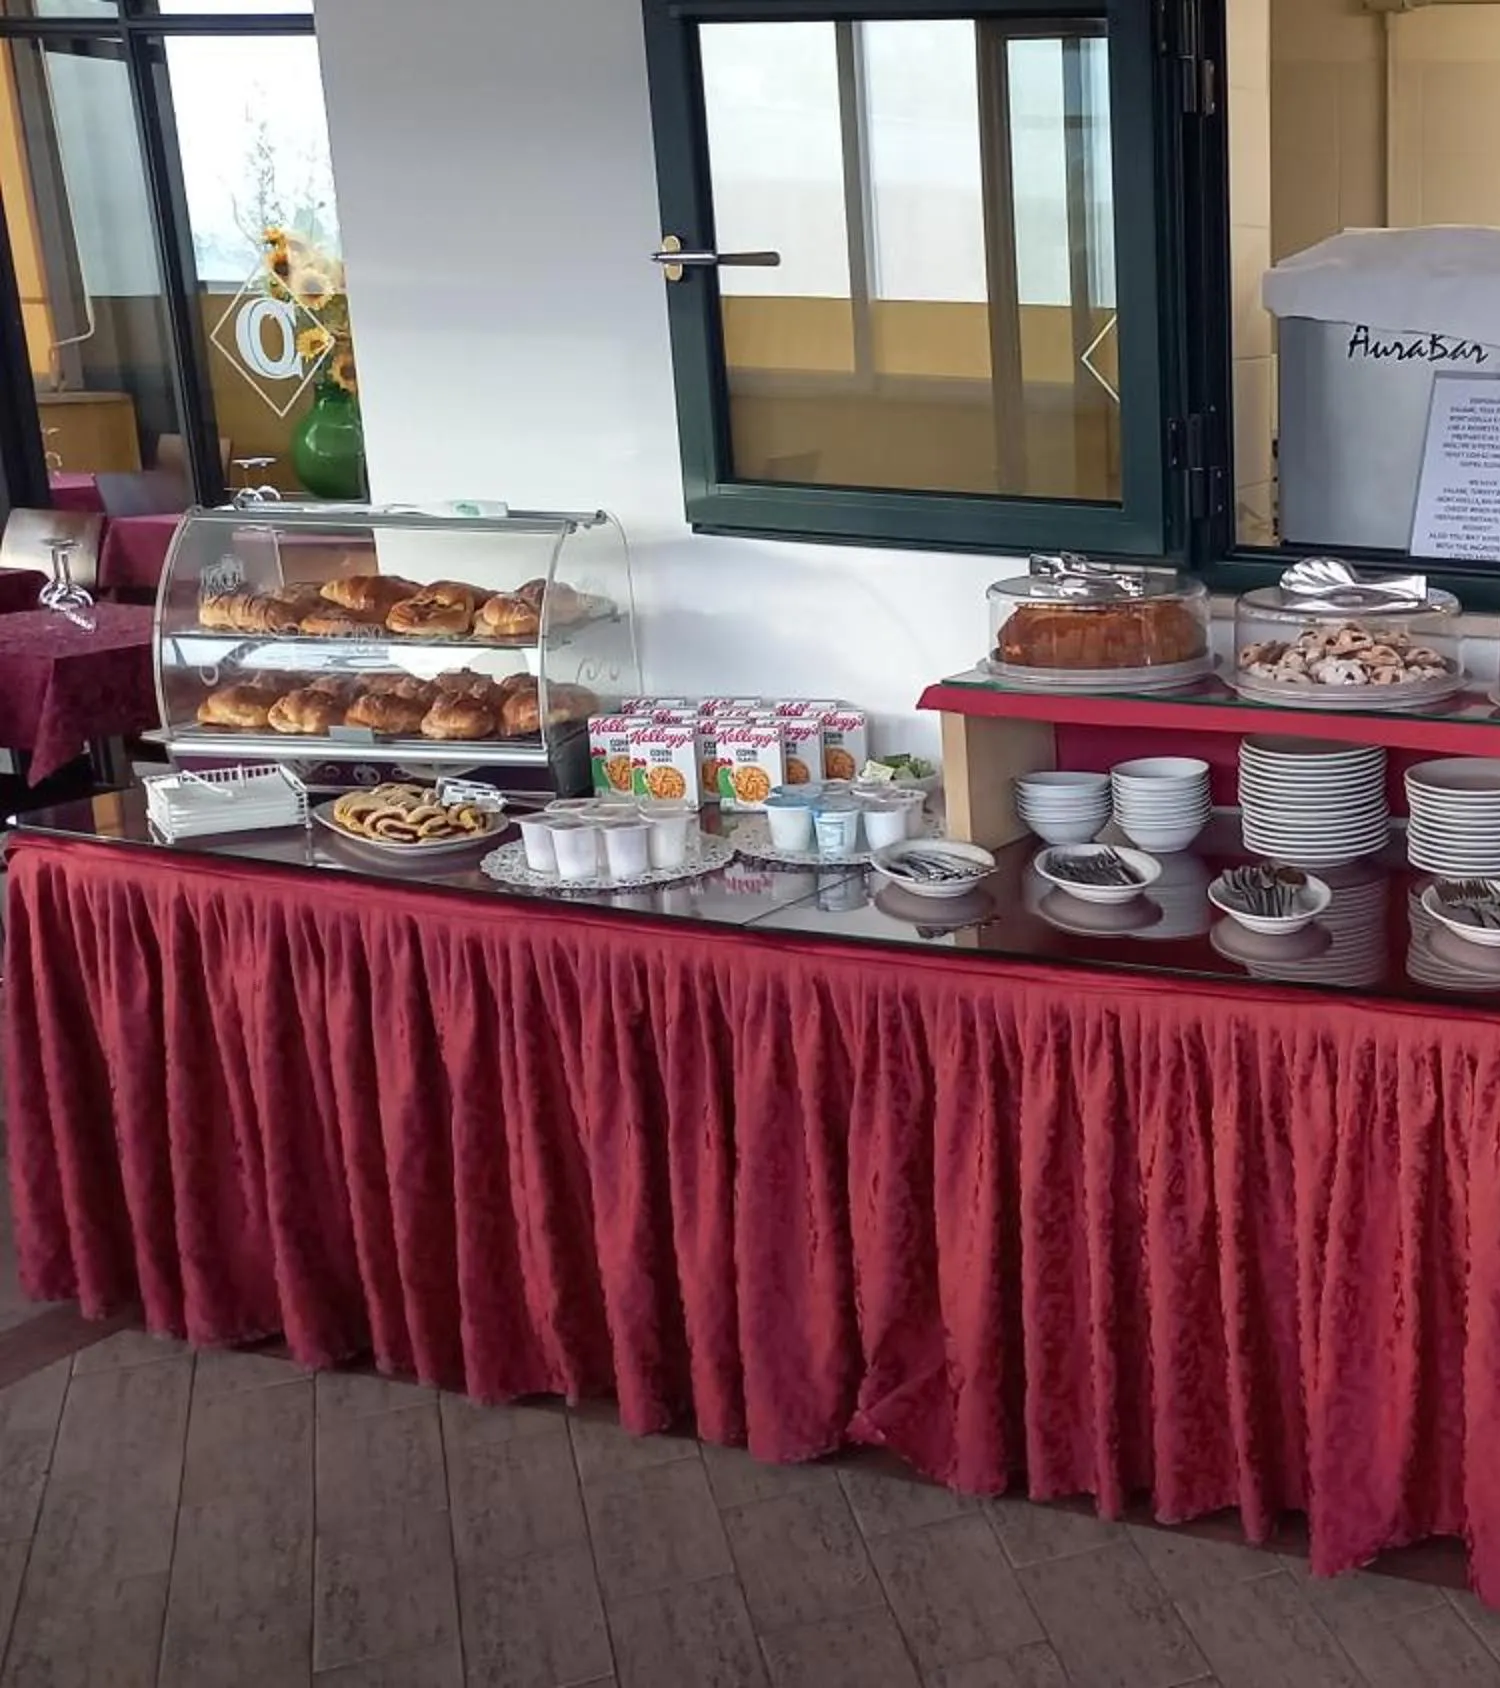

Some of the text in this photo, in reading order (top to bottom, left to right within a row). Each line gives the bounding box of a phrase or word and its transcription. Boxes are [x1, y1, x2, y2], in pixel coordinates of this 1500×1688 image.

[1348, 324, 1489, 364] AuraBar
[630, 726, 695, 748] Kellogg's
[717, 726, 781, 748] Kellogg's
